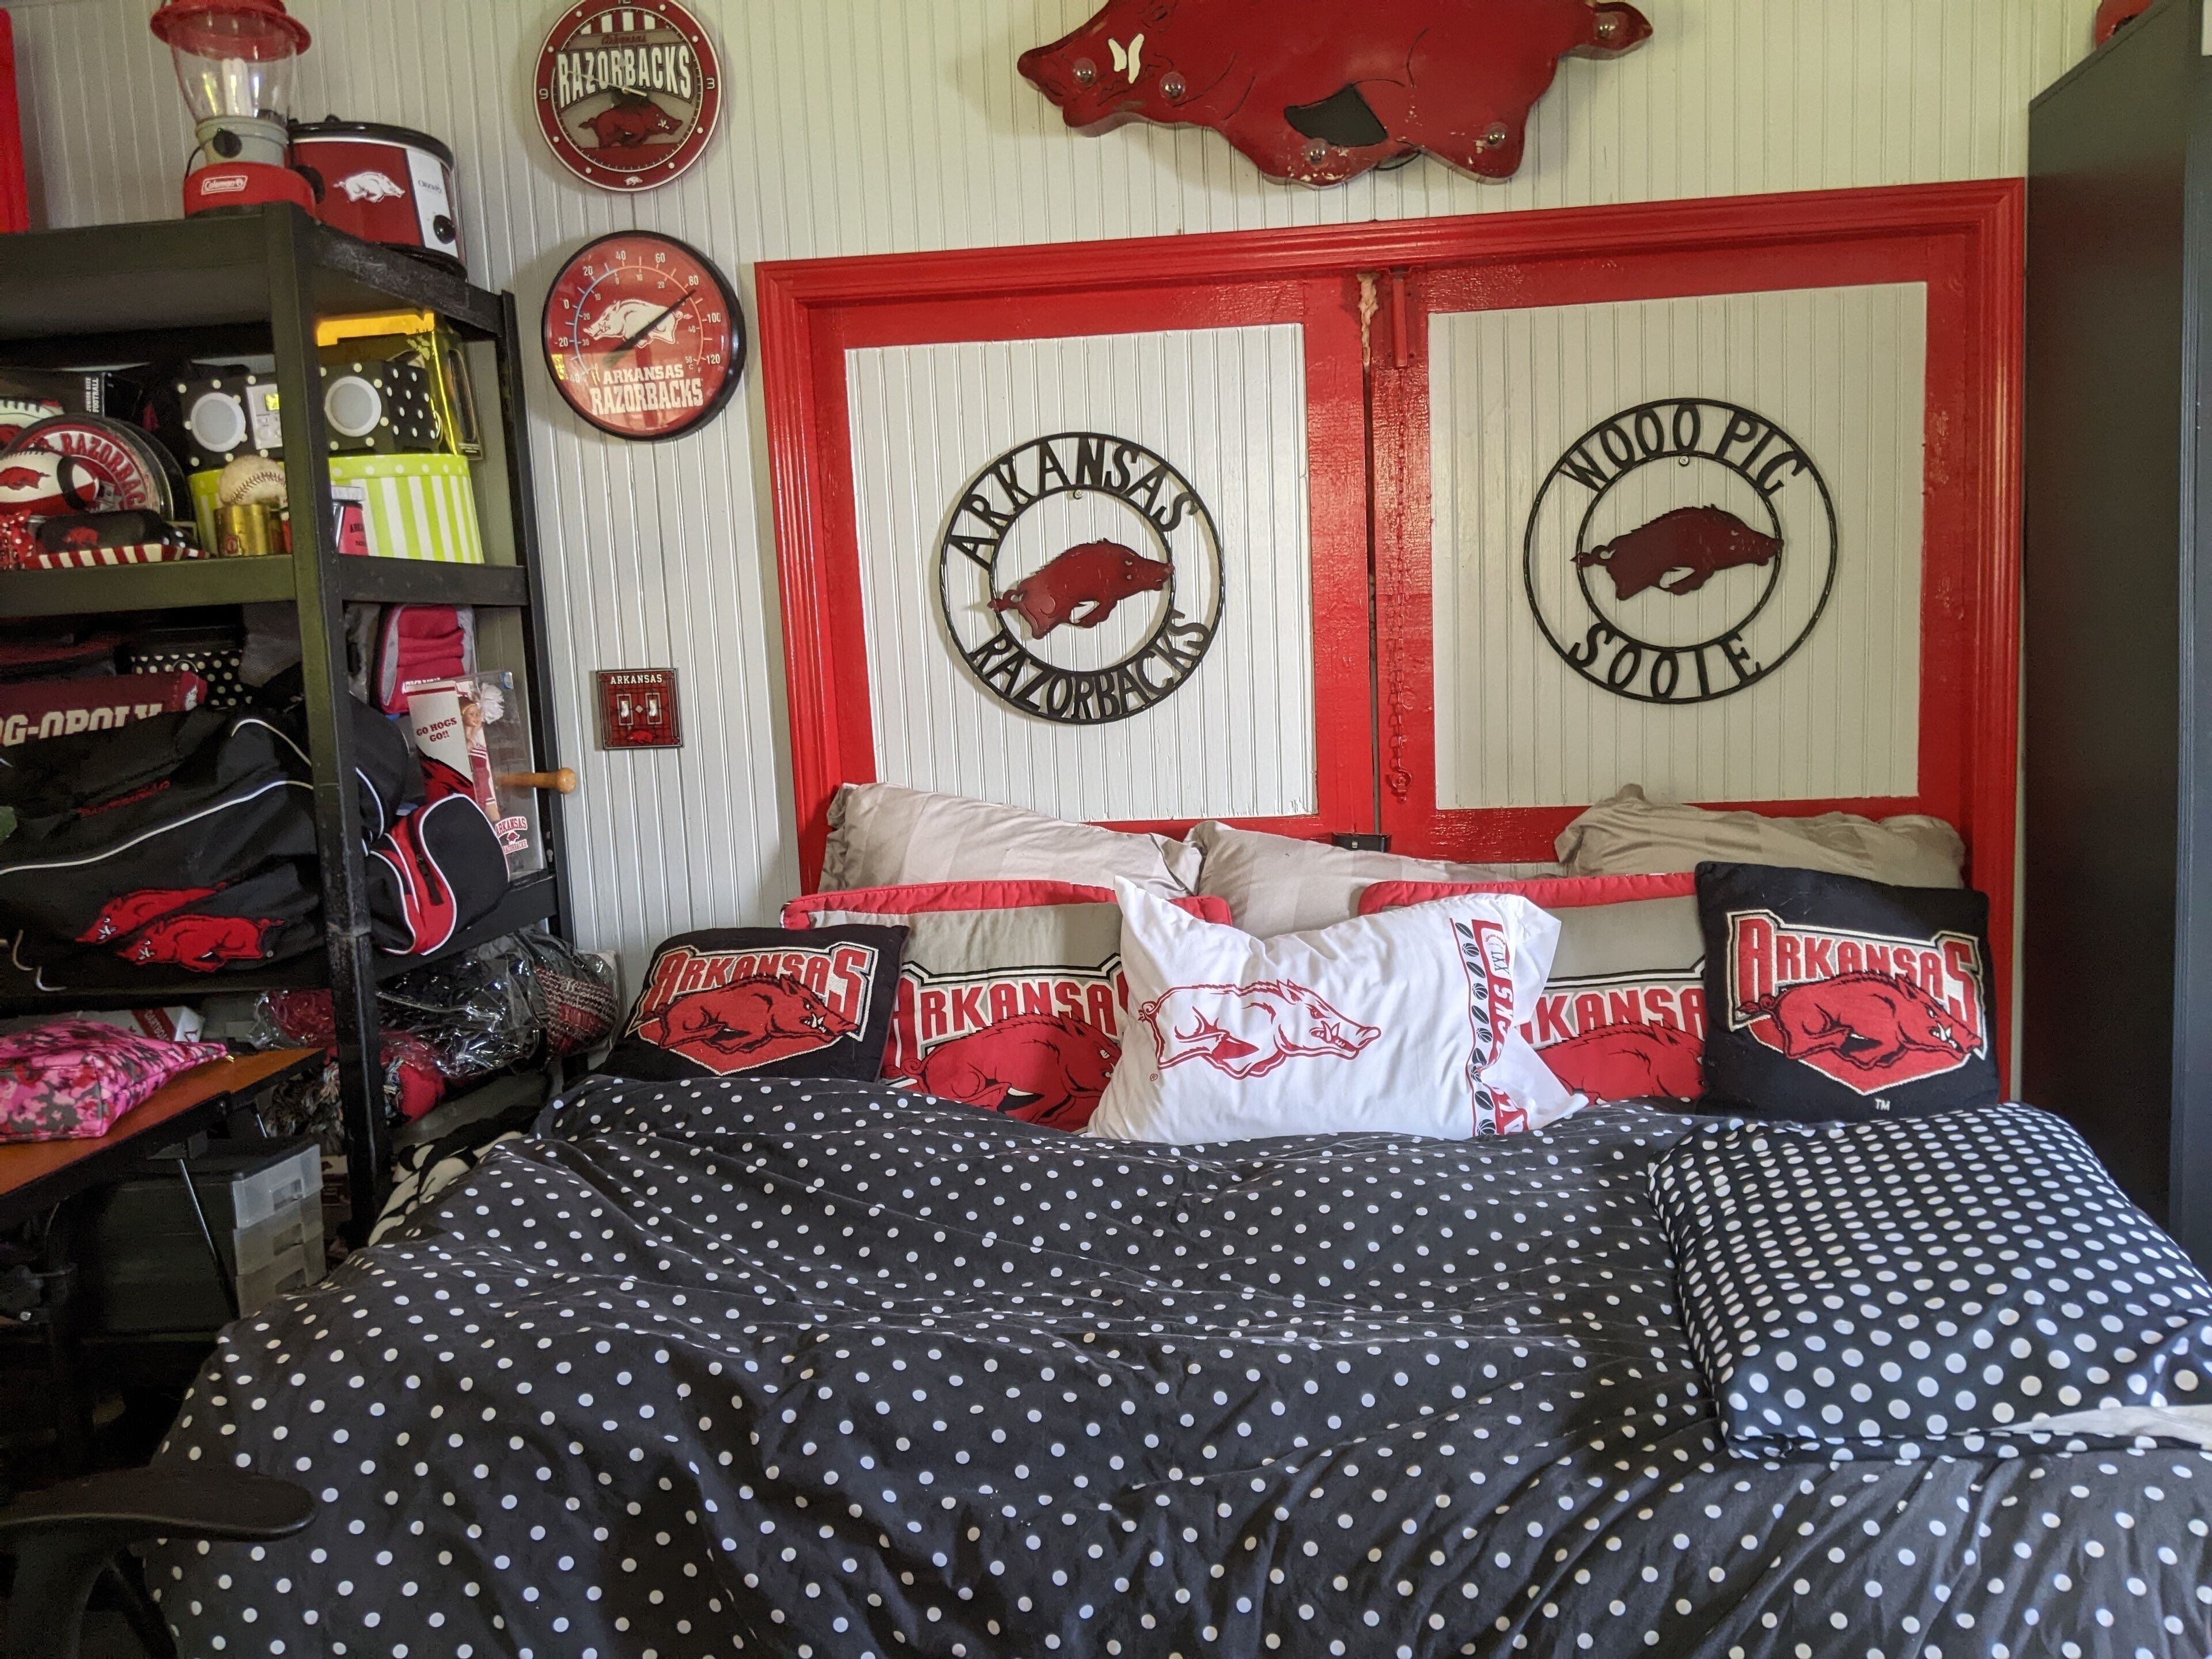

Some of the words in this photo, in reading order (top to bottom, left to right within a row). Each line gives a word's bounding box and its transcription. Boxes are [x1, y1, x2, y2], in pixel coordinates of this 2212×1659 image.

[556, 46, 692, 108] RAZORBACKS
[616, 250, 626, 260] 40
[655, 253, 665, 263] 60
[583, 266, 593, 276] 20
[688, 275, 699, 286] 80
[563, 300, 570, 309] 0
[707, 313, 721, 323] 100
[706, 354, 720, 364] 120
[603, 363, 684, 385] ARKANSAS
[589, 377, 704, 415] RAZORBACKS
[1557, 403, 1701, 493] WOOO
[1713, 411, 1809, 497] PIG
[59, 432, 146, 509] RAZORBAC
[949, 437, 1199, 573] ARKANSAS
[969, 608, 1212, 721] RAZORBACKS
[1566, 621, 1764, 699] SOOIE
[610, 674, 662, 685] ARKANSAS
[416, 726, 429, 736] GO
[429, 717, 457, 732] HOGS
[429, 730, 450, 742] GO!!
[495, 818, 527, 836] ARKANSAS
[1736, 916, 1980, 1024] ARKANSAS
[642, 944, 870, 1027] ARKANSAS
[881, 970, 1128, 1073] ARKANSA
[1874, 1098, 1891, 1111] TM
